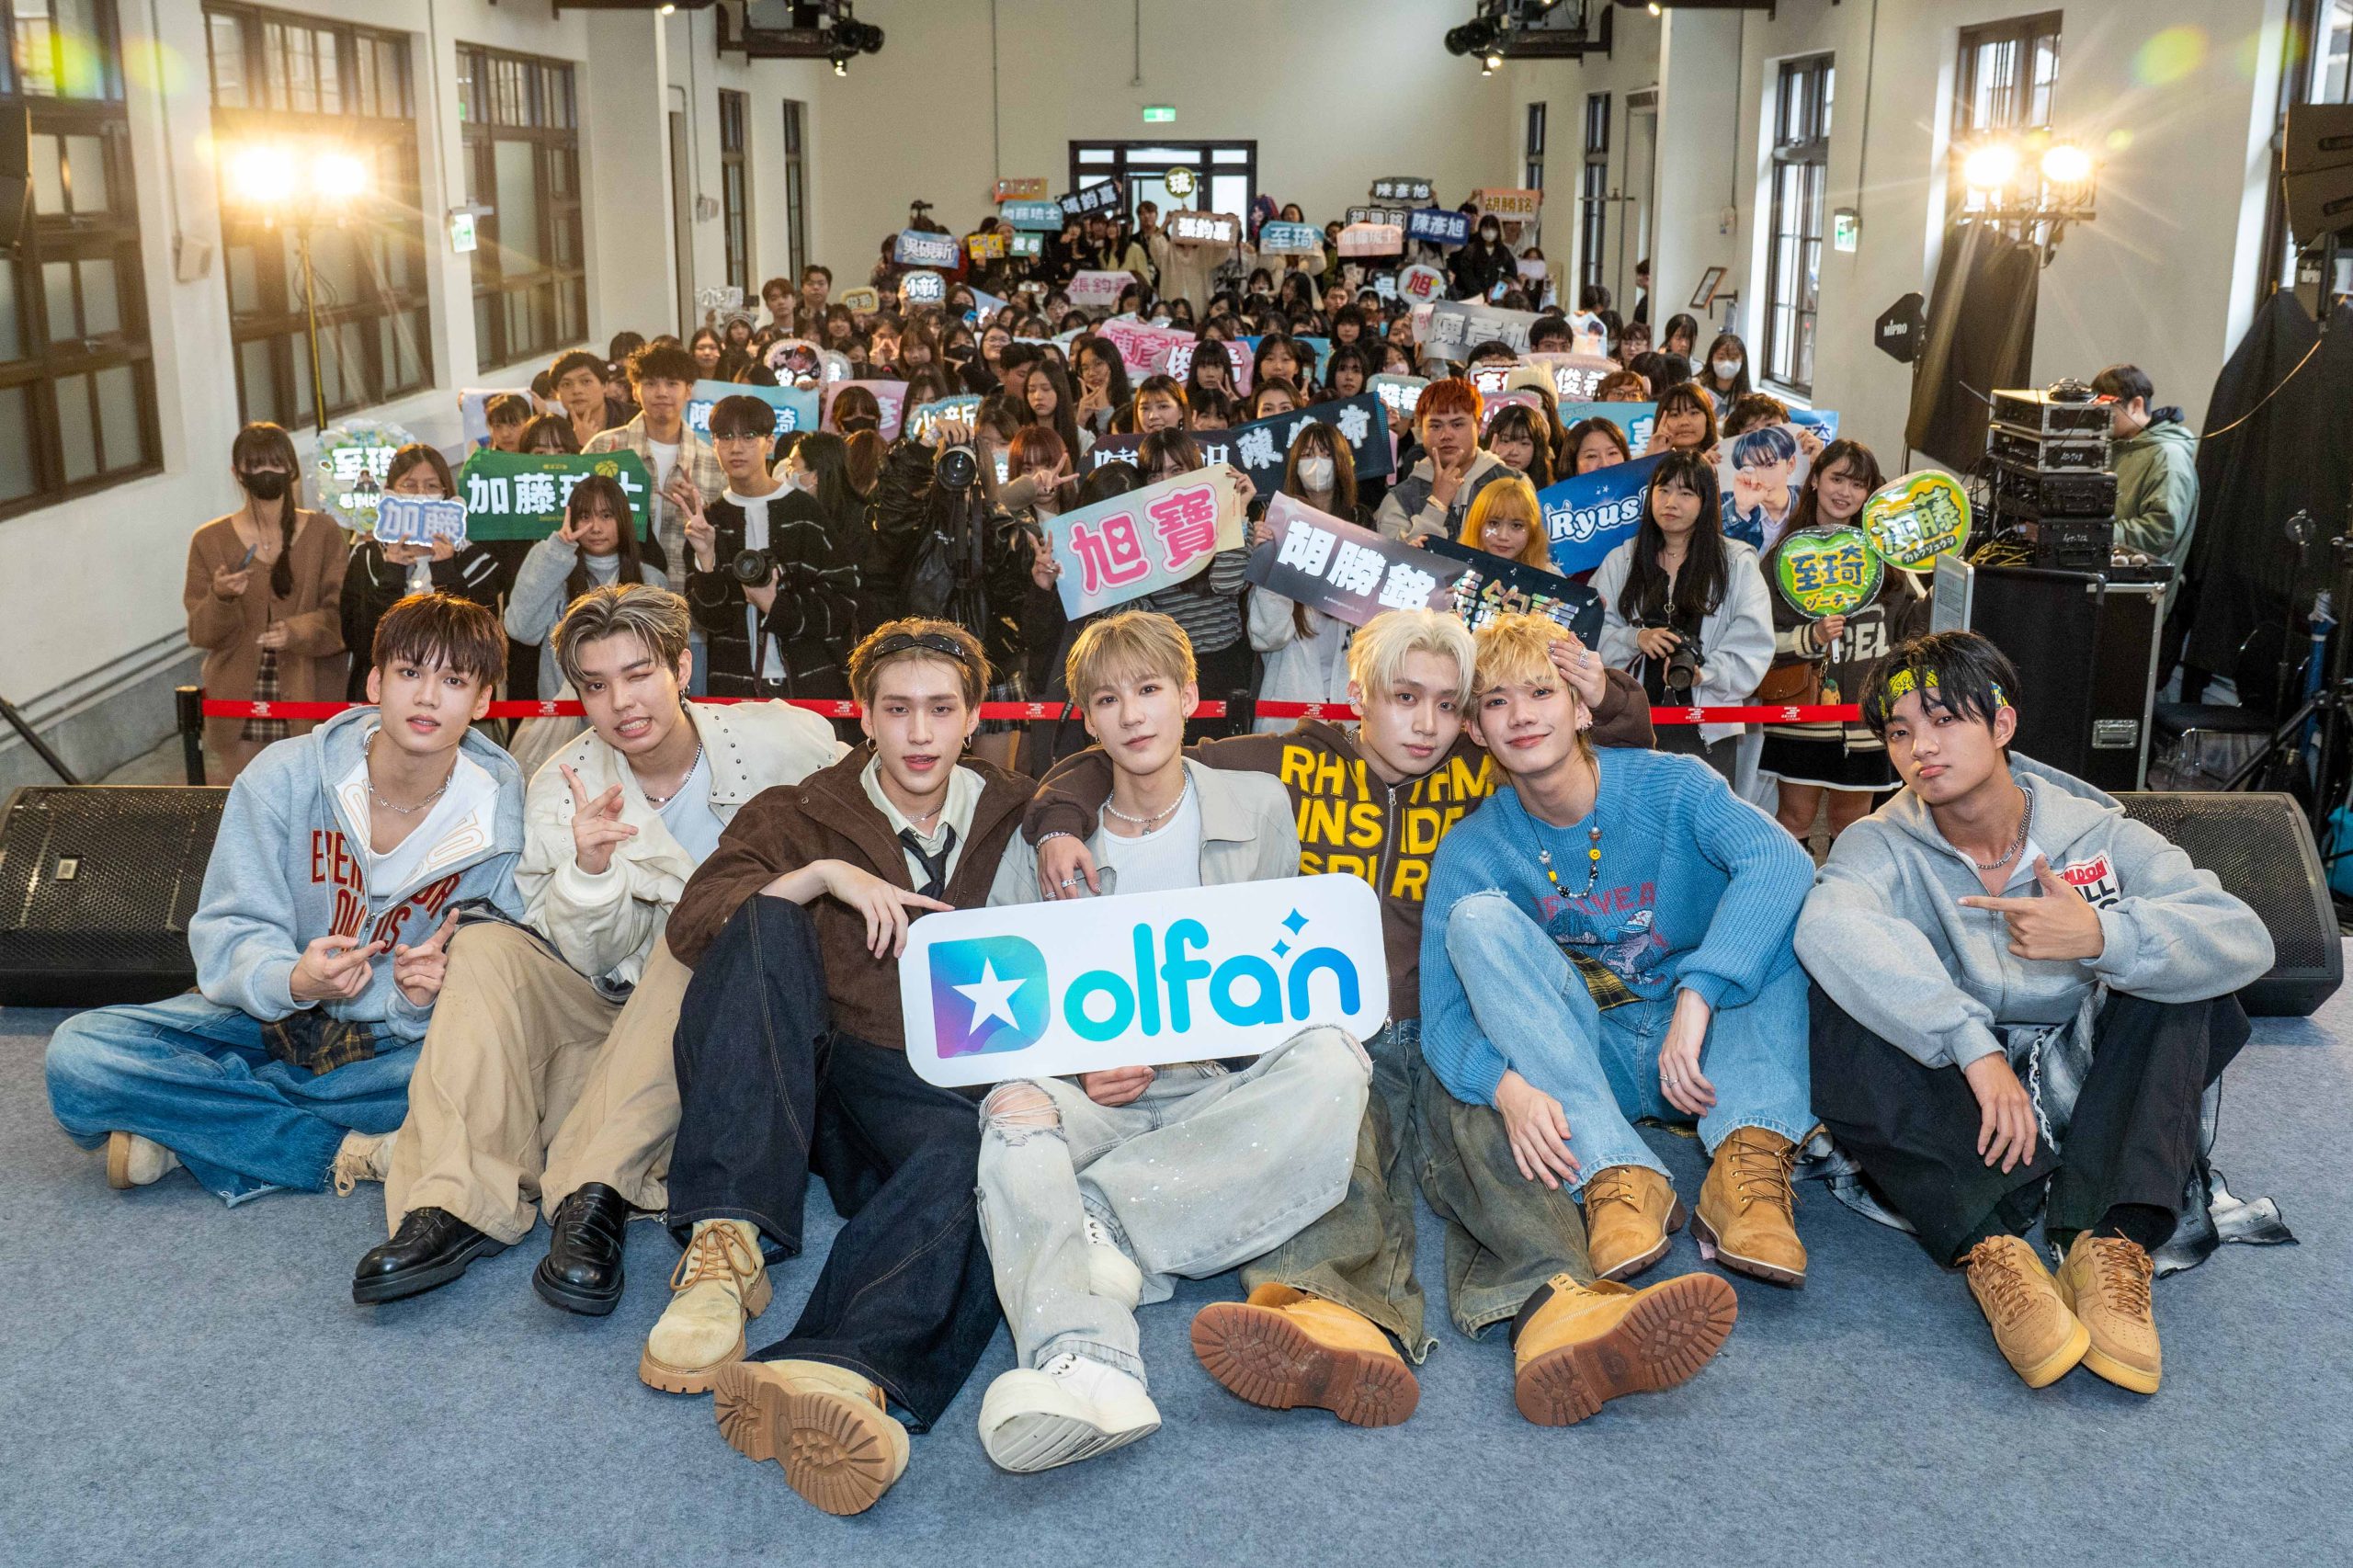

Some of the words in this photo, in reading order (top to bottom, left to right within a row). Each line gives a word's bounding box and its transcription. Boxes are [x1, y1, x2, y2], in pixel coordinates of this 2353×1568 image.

[1412, 212, 1466, 237] 陳彥旭
[1484, 196, 1532, 213] 胡勝銘
[1269, 227, 1314, 249] 至琦
[382, 501, 460, 540] 加藤
[1550, 486, 1649, 541] Ryus
[1071, 487, 1216, 592] 旭寶
[1277, 520, 1436, 610] 胡勝銘
[1792, 545, 1866, 593] 至琦
